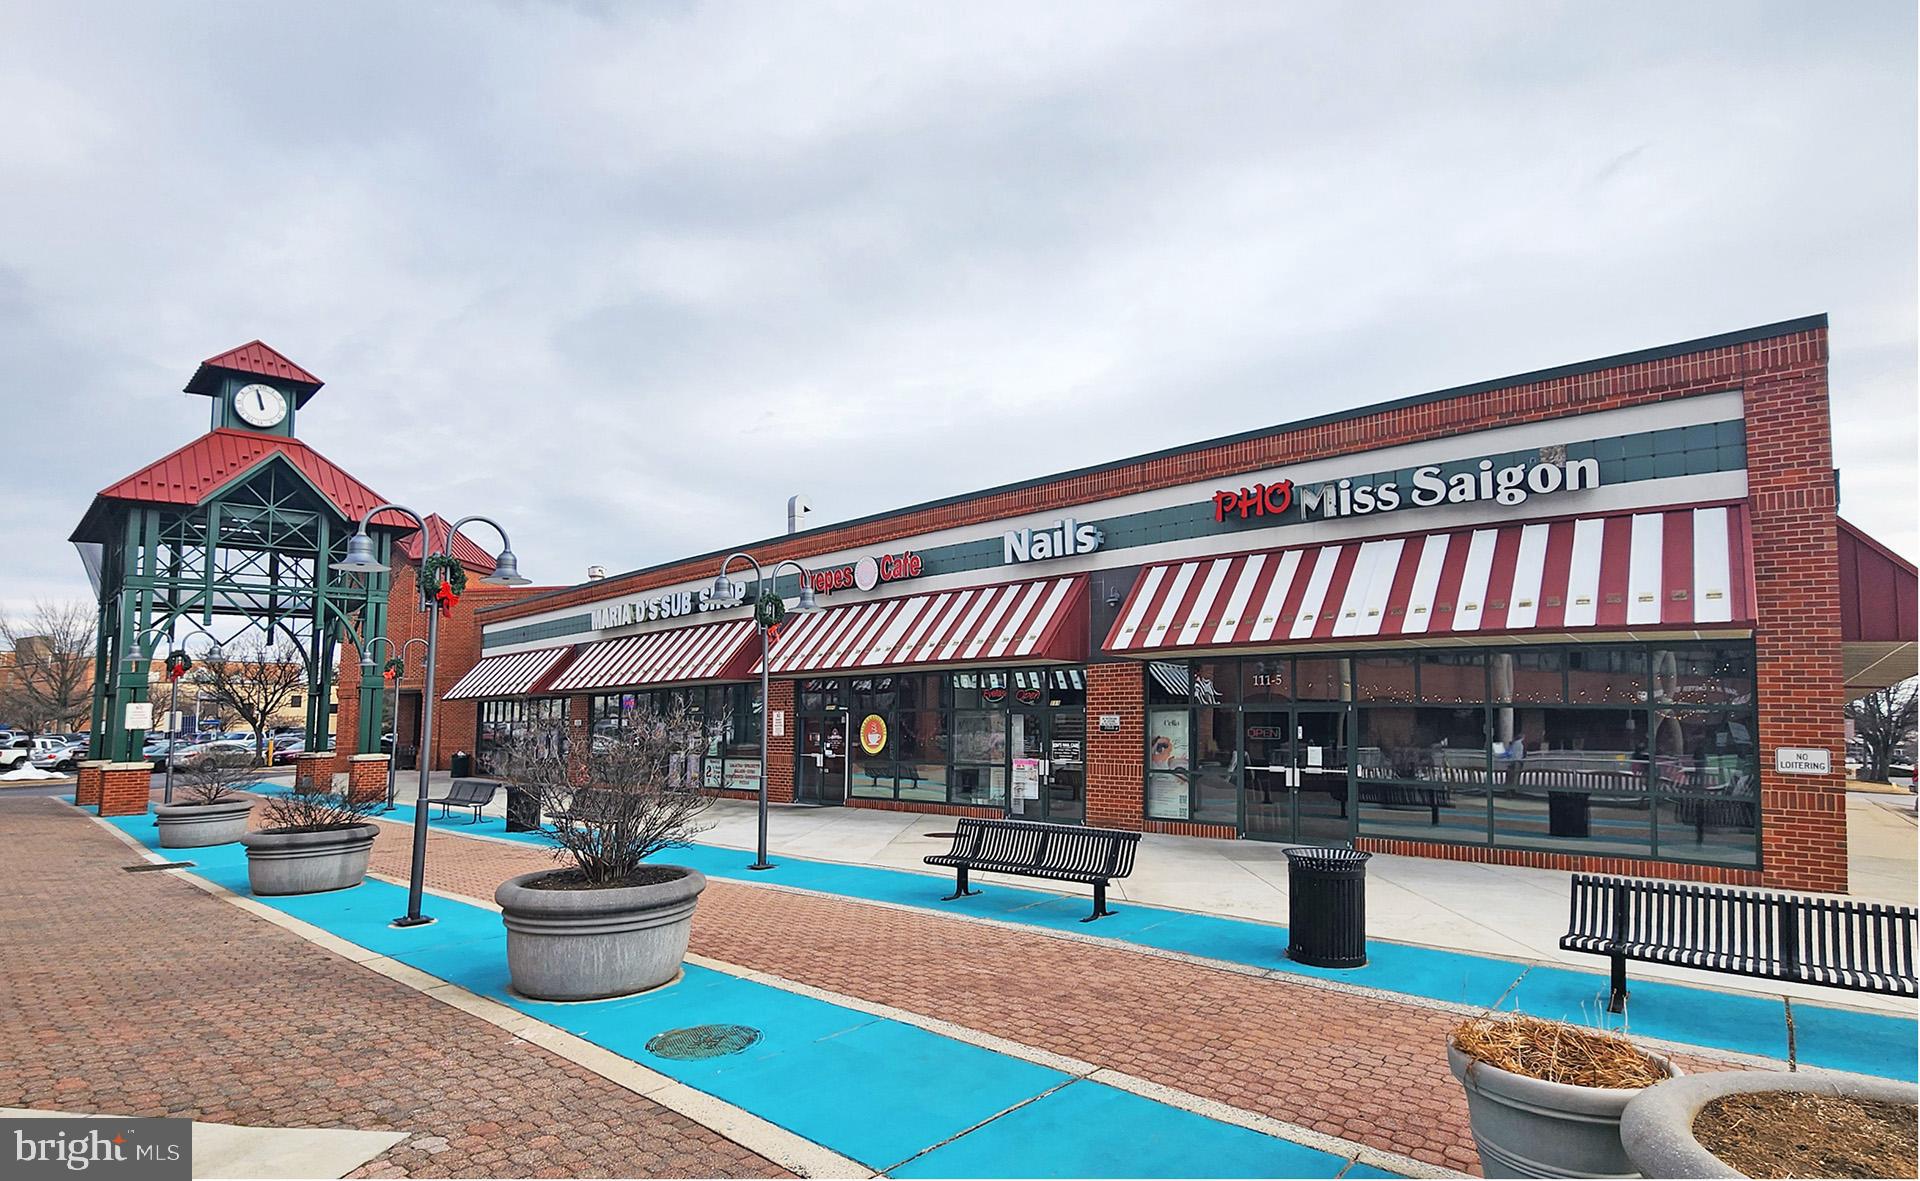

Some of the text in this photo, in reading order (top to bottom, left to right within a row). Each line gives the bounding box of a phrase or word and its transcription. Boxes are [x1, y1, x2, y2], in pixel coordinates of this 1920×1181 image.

[1300, 479, 1400, 521] Miss
[1411, 457, 1600, 506] Saigon
[1003, 518, 1099, 564] Nails
[591, 603, 633, 630] MARIA
[635, 598, 660, 623] D'S
[660, 591, 692, 618] SUB
[1253, 674, 1283, 686] 111-5
[1248, 728, 1279, 738] OPEN
[1780, 760, 1825, 770] LOITERING
